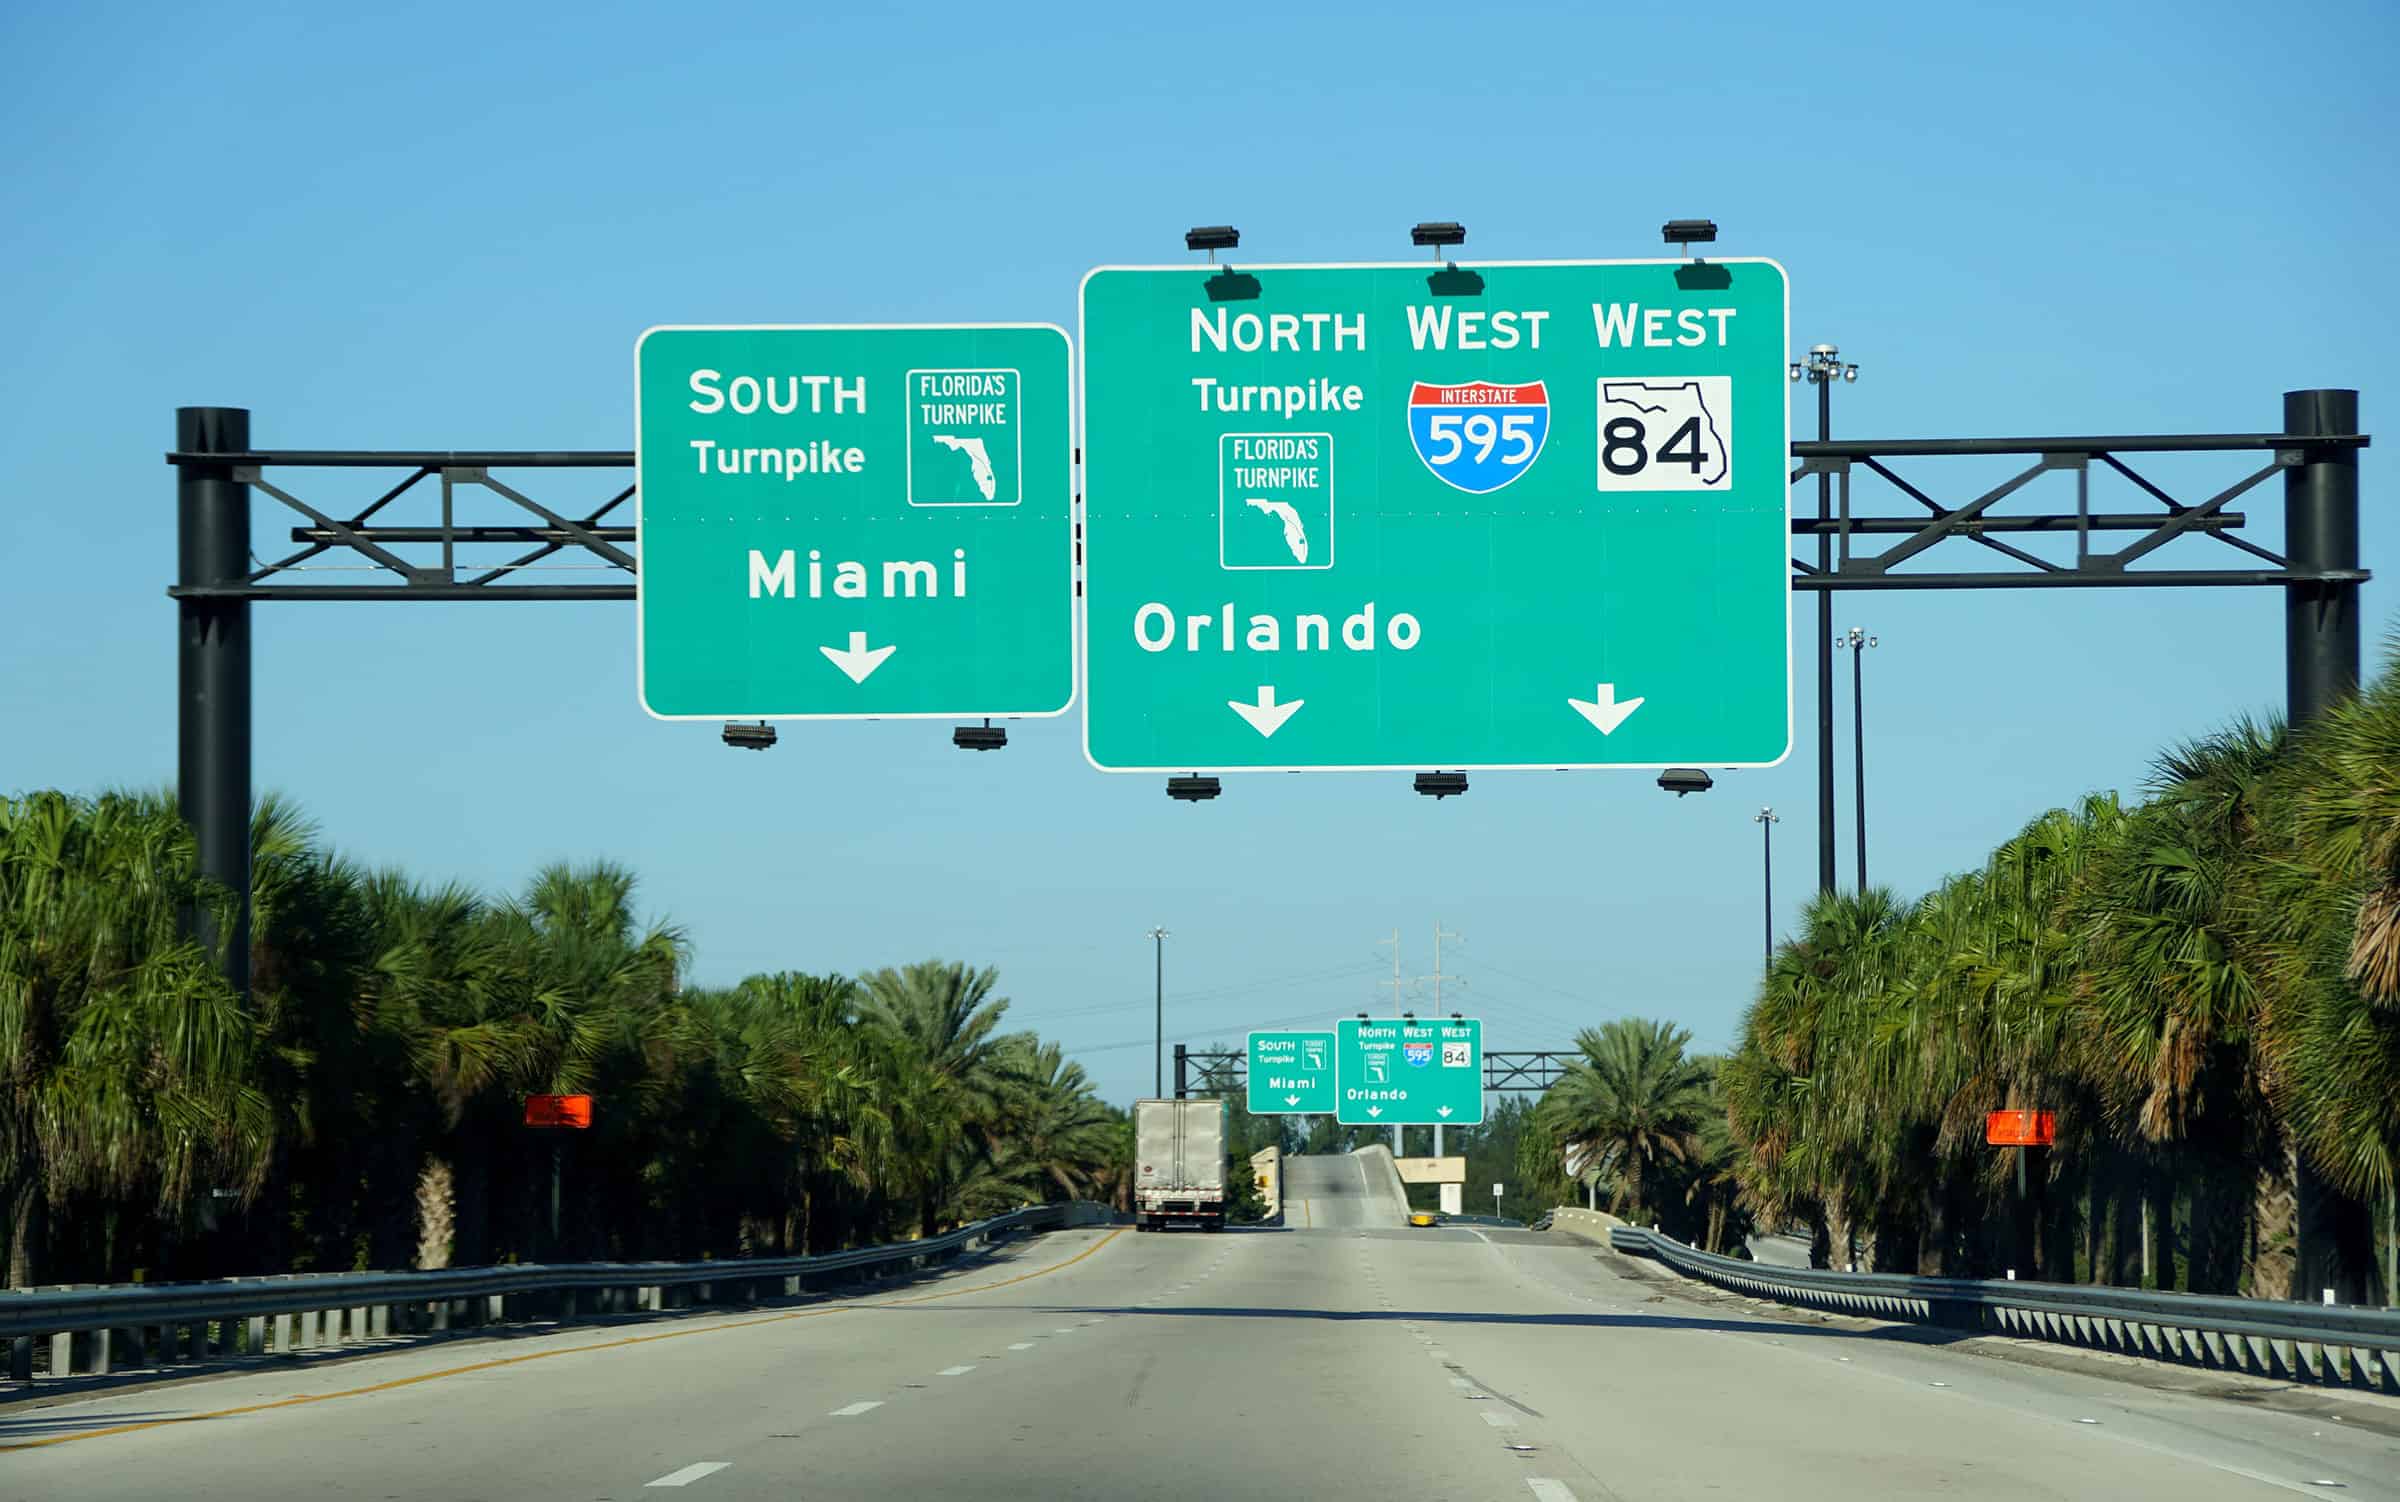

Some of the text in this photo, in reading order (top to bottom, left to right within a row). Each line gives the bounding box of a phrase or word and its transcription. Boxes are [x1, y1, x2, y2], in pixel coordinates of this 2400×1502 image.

[1192, 307, 1366, 353] NORTH
[1407, 305, 1550, 350] WEST
[1593, 303, 1737, 348] WEST
[689, 368, 866, 415] SOUTH
[921, 375, 1006, 397] FLORIDA'S
[1440, 388, 1518, 404] INTERSTATE
[1192, 377, 1364, 420] Turnpike
[921, 403, 1006, 425] TURNPIKE
[1234, 438, 1319, 460] FLORIDA'S
[1428, 414, 1536, 467] 595
[1602, 416, 1709, 476] 84
[690, 439, 865, 482] Turnpike
[1234, 467, 1319, 489] TURNPIKE
[748, 548, 967, 599] Miami
[1133, 601, 1421, 652] Orlando
[1357, 1027, 1396, 1038] NORTH
[1403, 1026, 1433, 1038] WEST
[1441, 1026, 1472, 1038] WEST
[1257, 1040, 1296, 1051] SOUTH
[1407, 1049, 1431, 1062] 595
[1443, 1051, 1466, 1064] 84
[1269, 1077, 1316, 1089] Miami
[1347, 1087, 1408, 1100] Orlando
